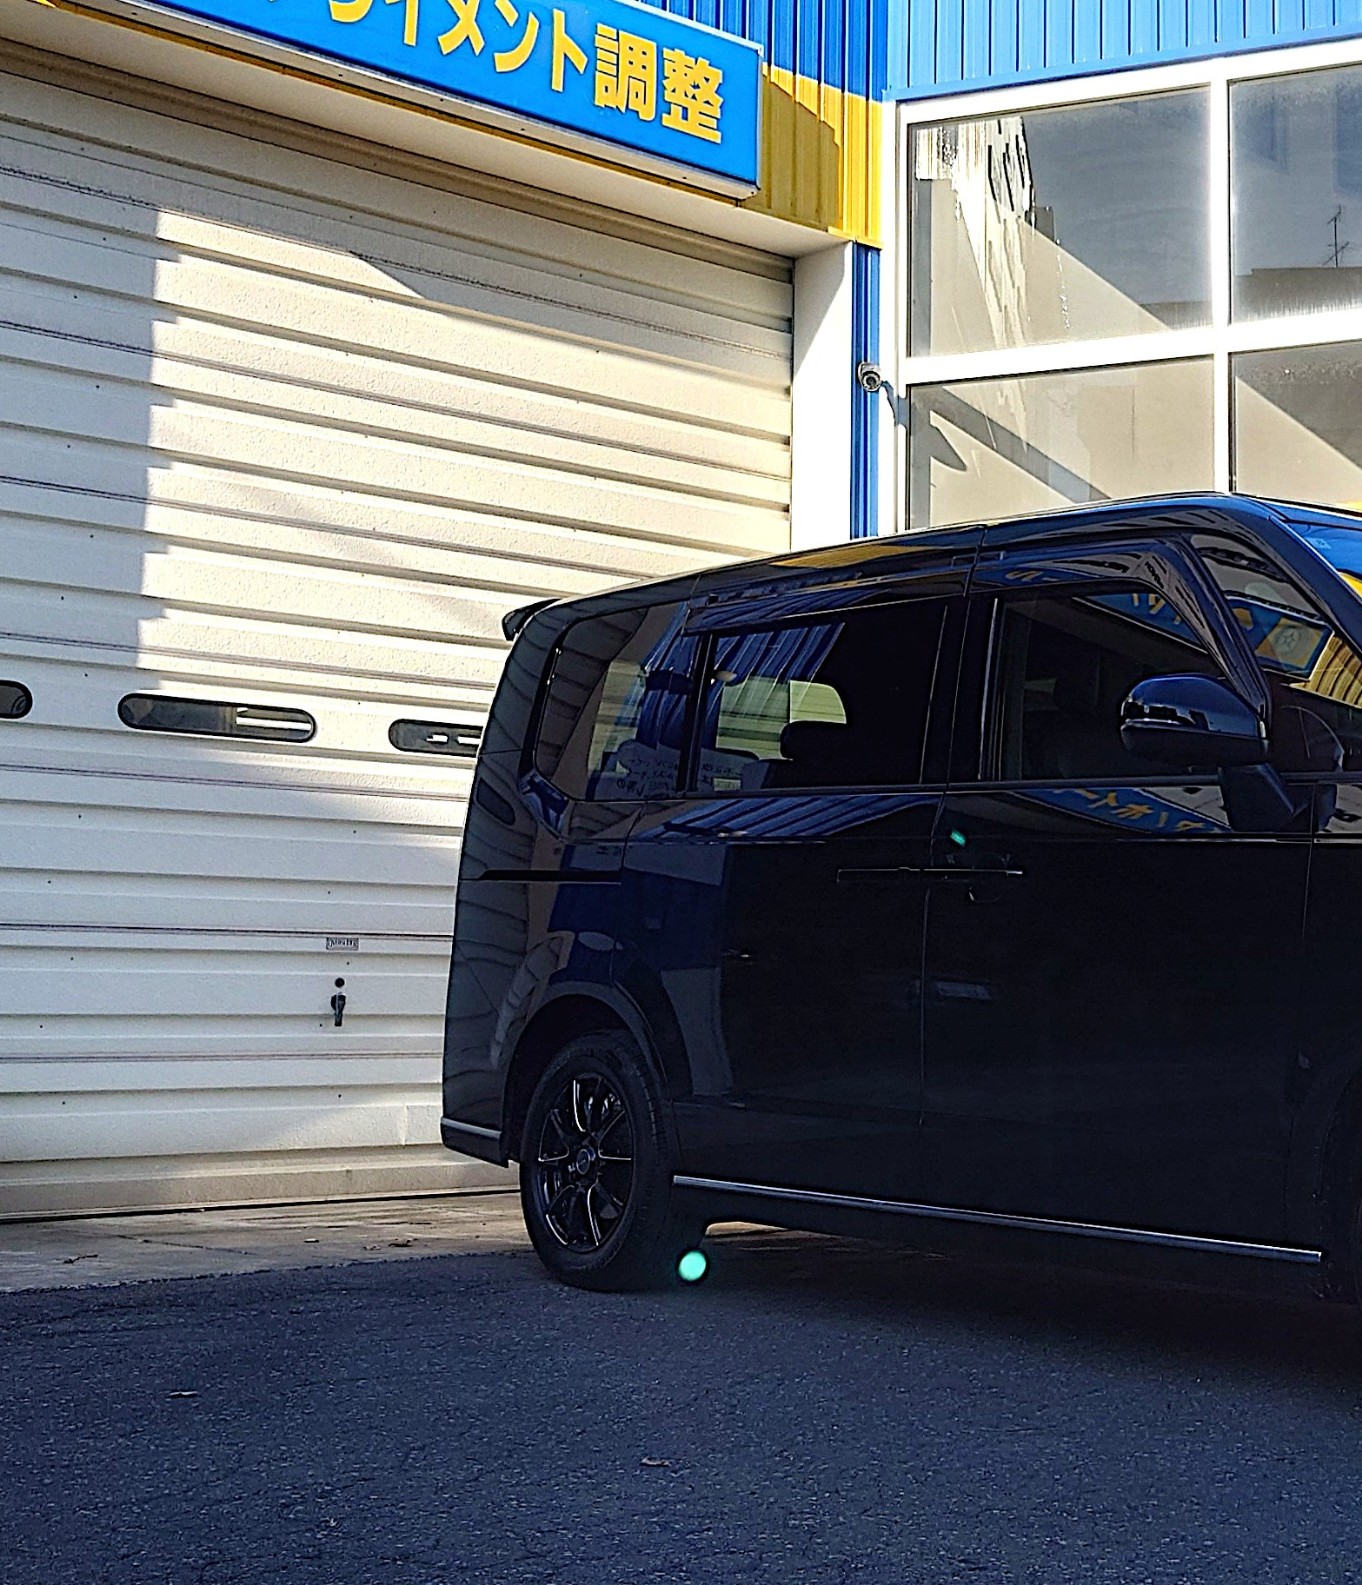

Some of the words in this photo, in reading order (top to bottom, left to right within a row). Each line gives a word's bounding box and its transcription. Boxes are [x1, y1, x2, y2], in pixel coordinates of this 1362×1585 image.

[328, 0, 722, 143] イメント調整
